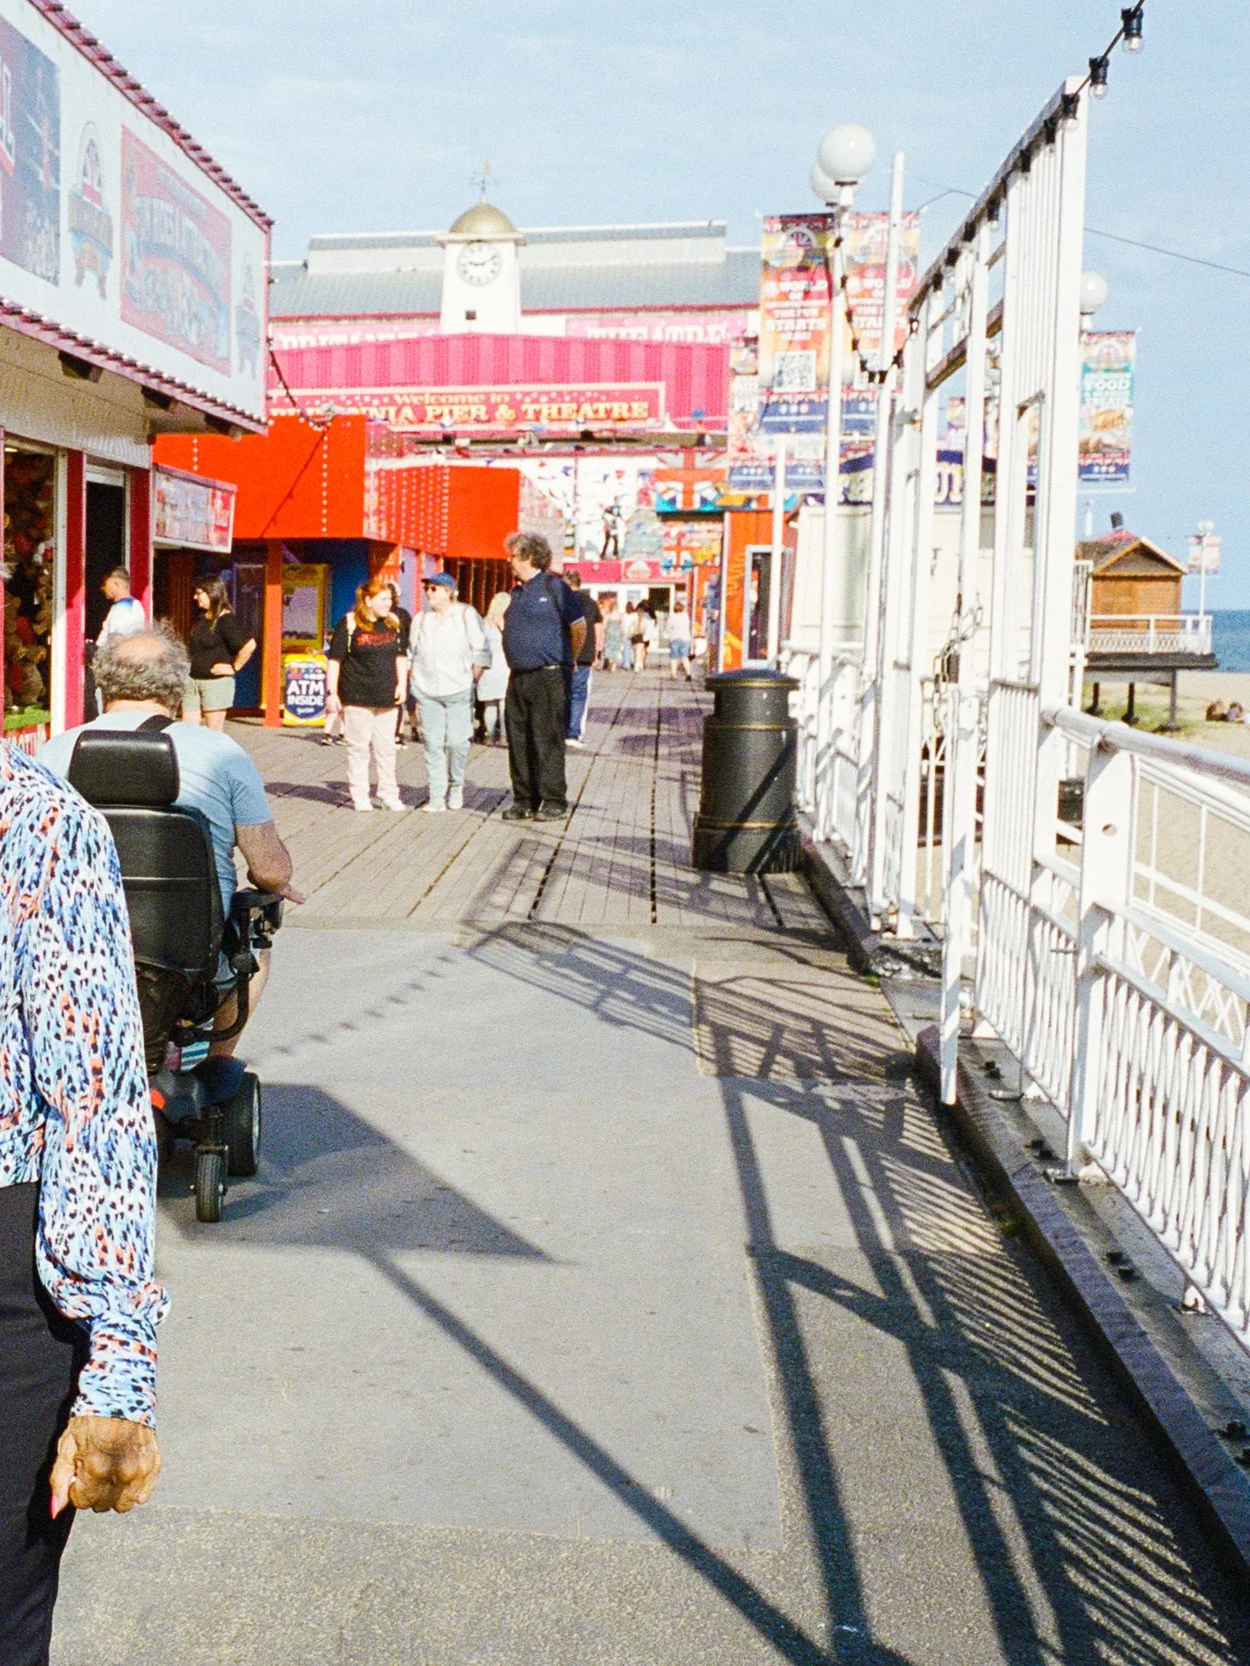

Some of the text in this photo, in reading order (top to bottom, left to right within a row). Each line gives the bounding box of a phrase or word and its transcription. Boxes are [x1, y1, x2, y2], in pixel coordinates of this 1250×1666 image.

[393, 392, 510, 405] Welcome to
[425, 404, 488, 421] PIER
[495, 404, 517, 420] &
[521, 402, 649, 420] THEATRE
[287, 680, 325, 695] ATM
[287, 695, 324, 706] INSIDE
